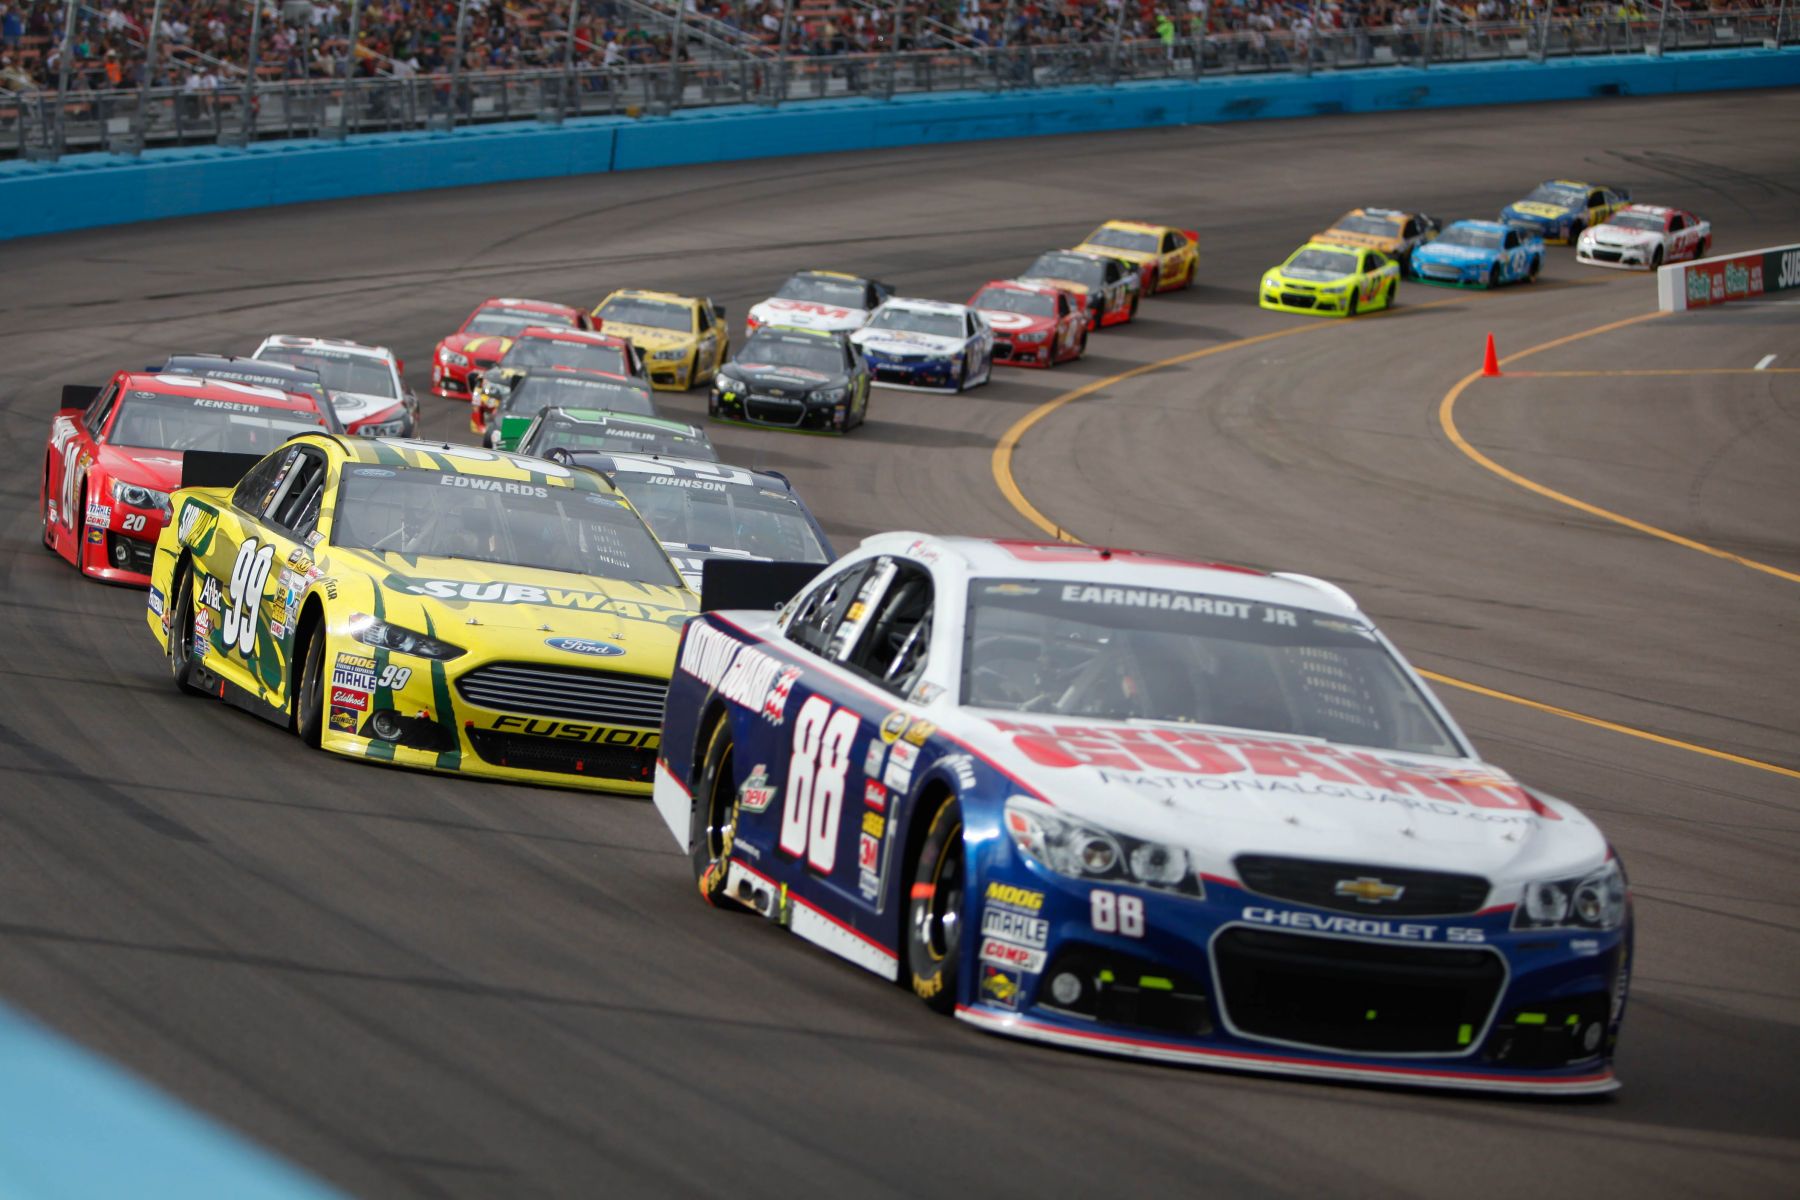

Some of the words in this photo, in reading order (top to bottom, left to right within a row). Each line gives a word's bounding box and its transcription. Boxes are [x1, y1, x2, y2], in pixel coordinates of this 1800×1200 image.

[206, 370, 286, 386] KESELOWSKI
[193, 398, 260, 414] KENSETH
[605, 427, 656, 441] HAMLIN
[439, 474, 549, 499] EDWARDS
[646, 474, 727, 493] JOHNSON
[121, 513, 147, 532] 20
[222, 537, 275, 654] 99
[407, 580, 697, 624] SUBWAY
[1061, 585, 1252, 619] EARNHARDT
[1261, 607, 1297, 627] JR
[563, 640, 610, 655] Ford
[338, 654, 377, 669] MOOG
[333, 670, 376, 690] MAHLE
[378, 665, 412, 690] 99
[779, 693, 862, 876] 88
[985, 881, 1044, 910] MOOG
[1090, 889, 1144, 938] 88
[1242, 907, 1438, 941] CHEVROLET
[1447, 927, 1486, 943] SS
[986, 911, 1046, 942] MAHLE
